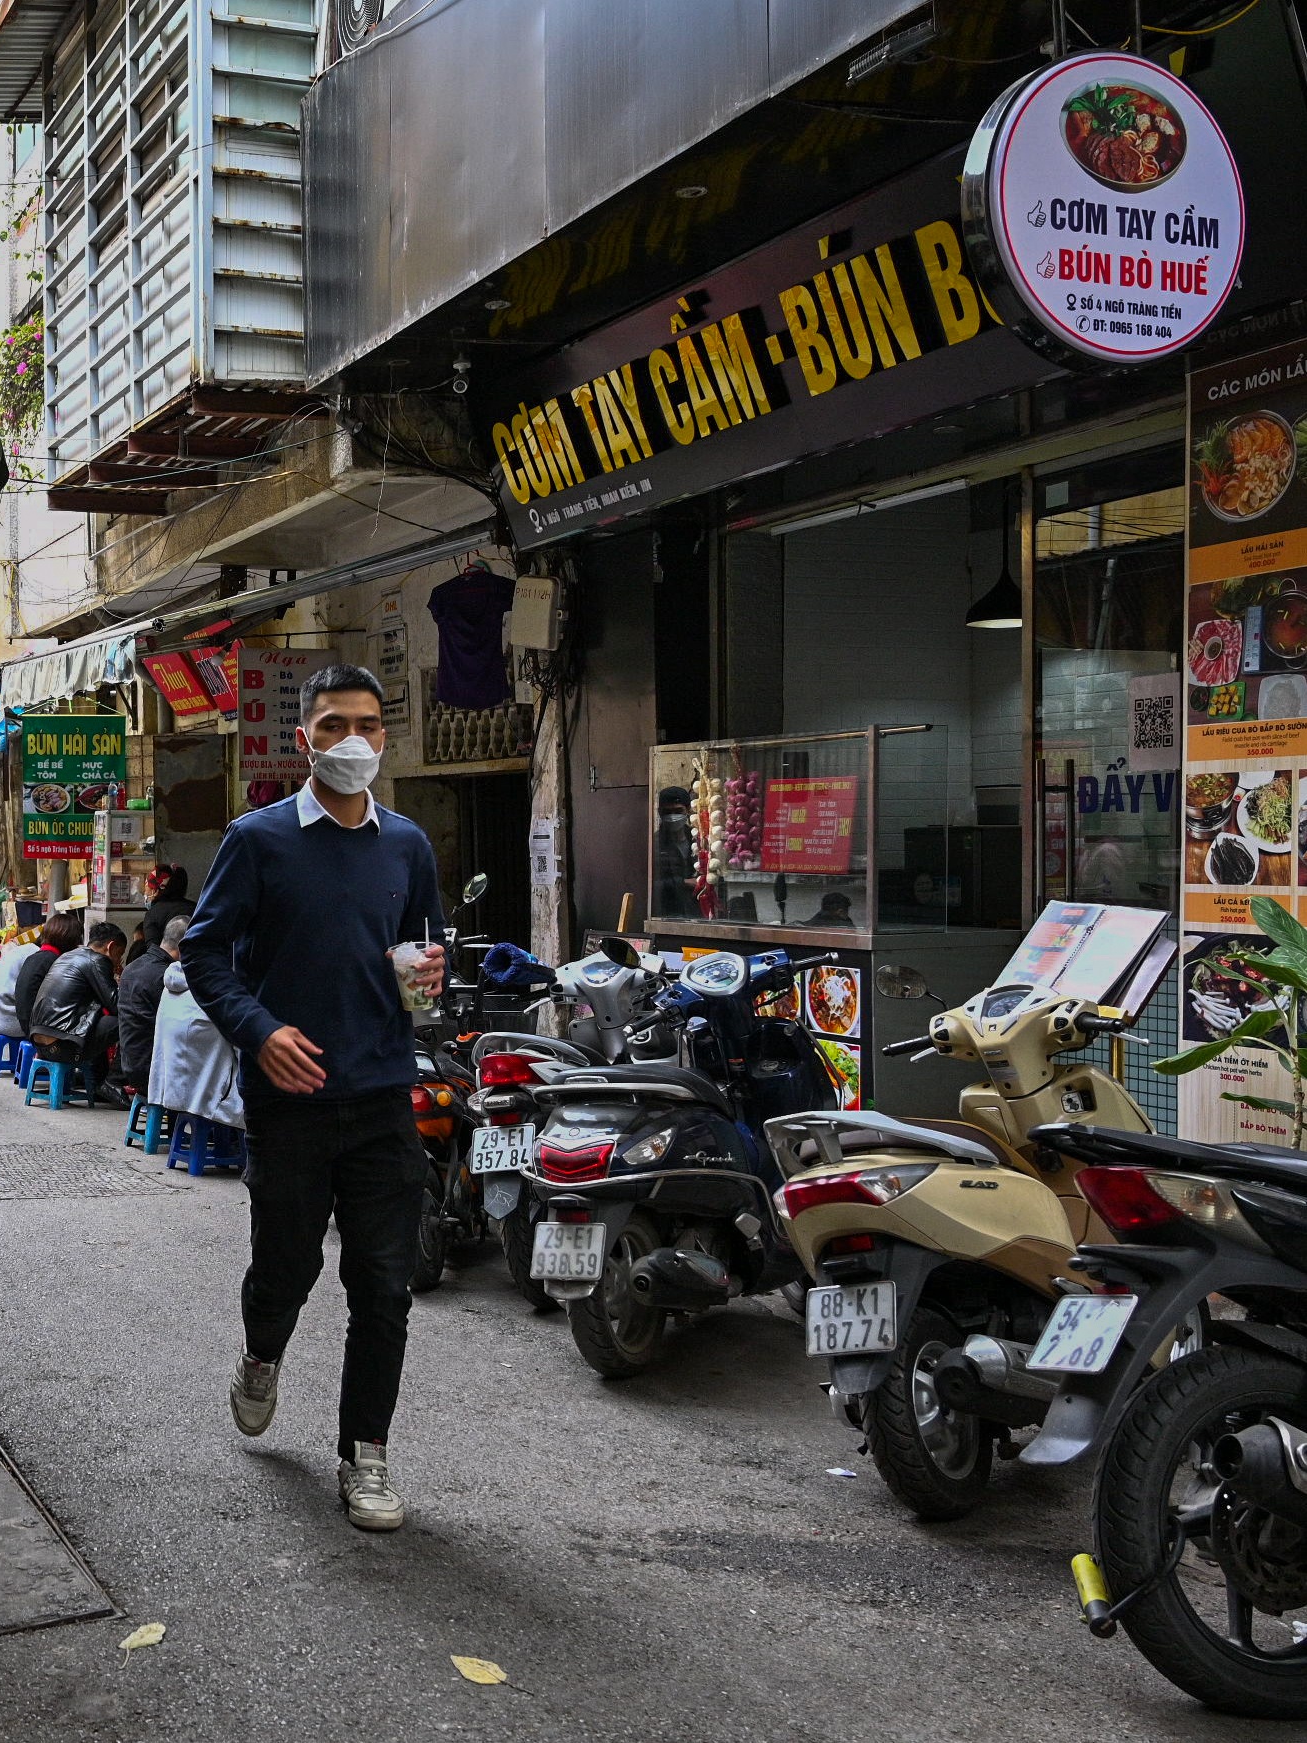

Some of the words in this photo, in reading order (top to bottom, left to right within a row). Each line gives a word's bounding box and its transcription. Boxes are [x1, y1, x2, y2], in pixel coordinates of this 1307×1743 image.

[1050, 198, 1108, 236] CƠM
[1116, 205, 1157, 241] TAY
[1165, 204, 1220, 249] CẦM
[1058, 244, 1111, 285] BÚN
[1120, 250, 1152, 289] BÒ
[1160, 255, 1210, 296] HUẾ
[1080, 293, 1094, 310] SỐ
[1096, 299, 1103, 311] 4
[1104, 298, 1125, 314] NGÕ
[1127, 301, 1159, 318] TRÀNG
[1093, 319, 1107, 332] ĐT:
[1109, 320, 1133, 335] 0965
[1135, 322, 1152, 337] 168
[1154, 326, 1172, 339] 404
[492, 398, 586, 505] CƠM
[570, 362, 654, 474] TAY
[648, 296, 772, 446] CẦM
[779, 235, 923, 397] BÚN
[914, 219, 1005, 346] B
[1208, 379, 1241, 400] CÁC
[1245, 367, 1282, 391] MÓN
[1286, 352, 1307, 380] LẨ
[1231, 727, 1246, 735] CUA
[1247, 725, 1257, 733] BÒ
[1275, 723, 1286, 731] BÒ
[27, 729, 58, 756] BÚN
[62, 728, 87, 756] HẢI
[92, 728, 121, 756] SẢN
[36, 771, 57, 779] TÔM
[81, 770, 101, 779] CHẢ
[82, 761, 103, 771] MỰC
[1077, 757, 1146, 813] ĐẨY
[28, 818, 49, 835] BÚN
[52, 818, 64, 835] ỐC
[68, 819, 94, 836] CHUỐ
[27, 844, 35, 853] Số
[36, 845, 40, 853] 5
[1220, 915, 1246, 923] 250.000
[1219, 1073, 1245, 1082] 300.000
[1249, 1069, 1262, 1077] herbs
[480, 1128, 525, 1150] 29-E1
[1255, 1123, 1266, 1132] BÒ
[1268, 1126, 1287, 1135] THÊM
[474, 1147, 529, 1171] 357.84
[544, 1226, 593, 1250] 29-E1
[820, 1287, 880, 1319] 88-K1
[812, 1319, 891, 1351] 187.74
